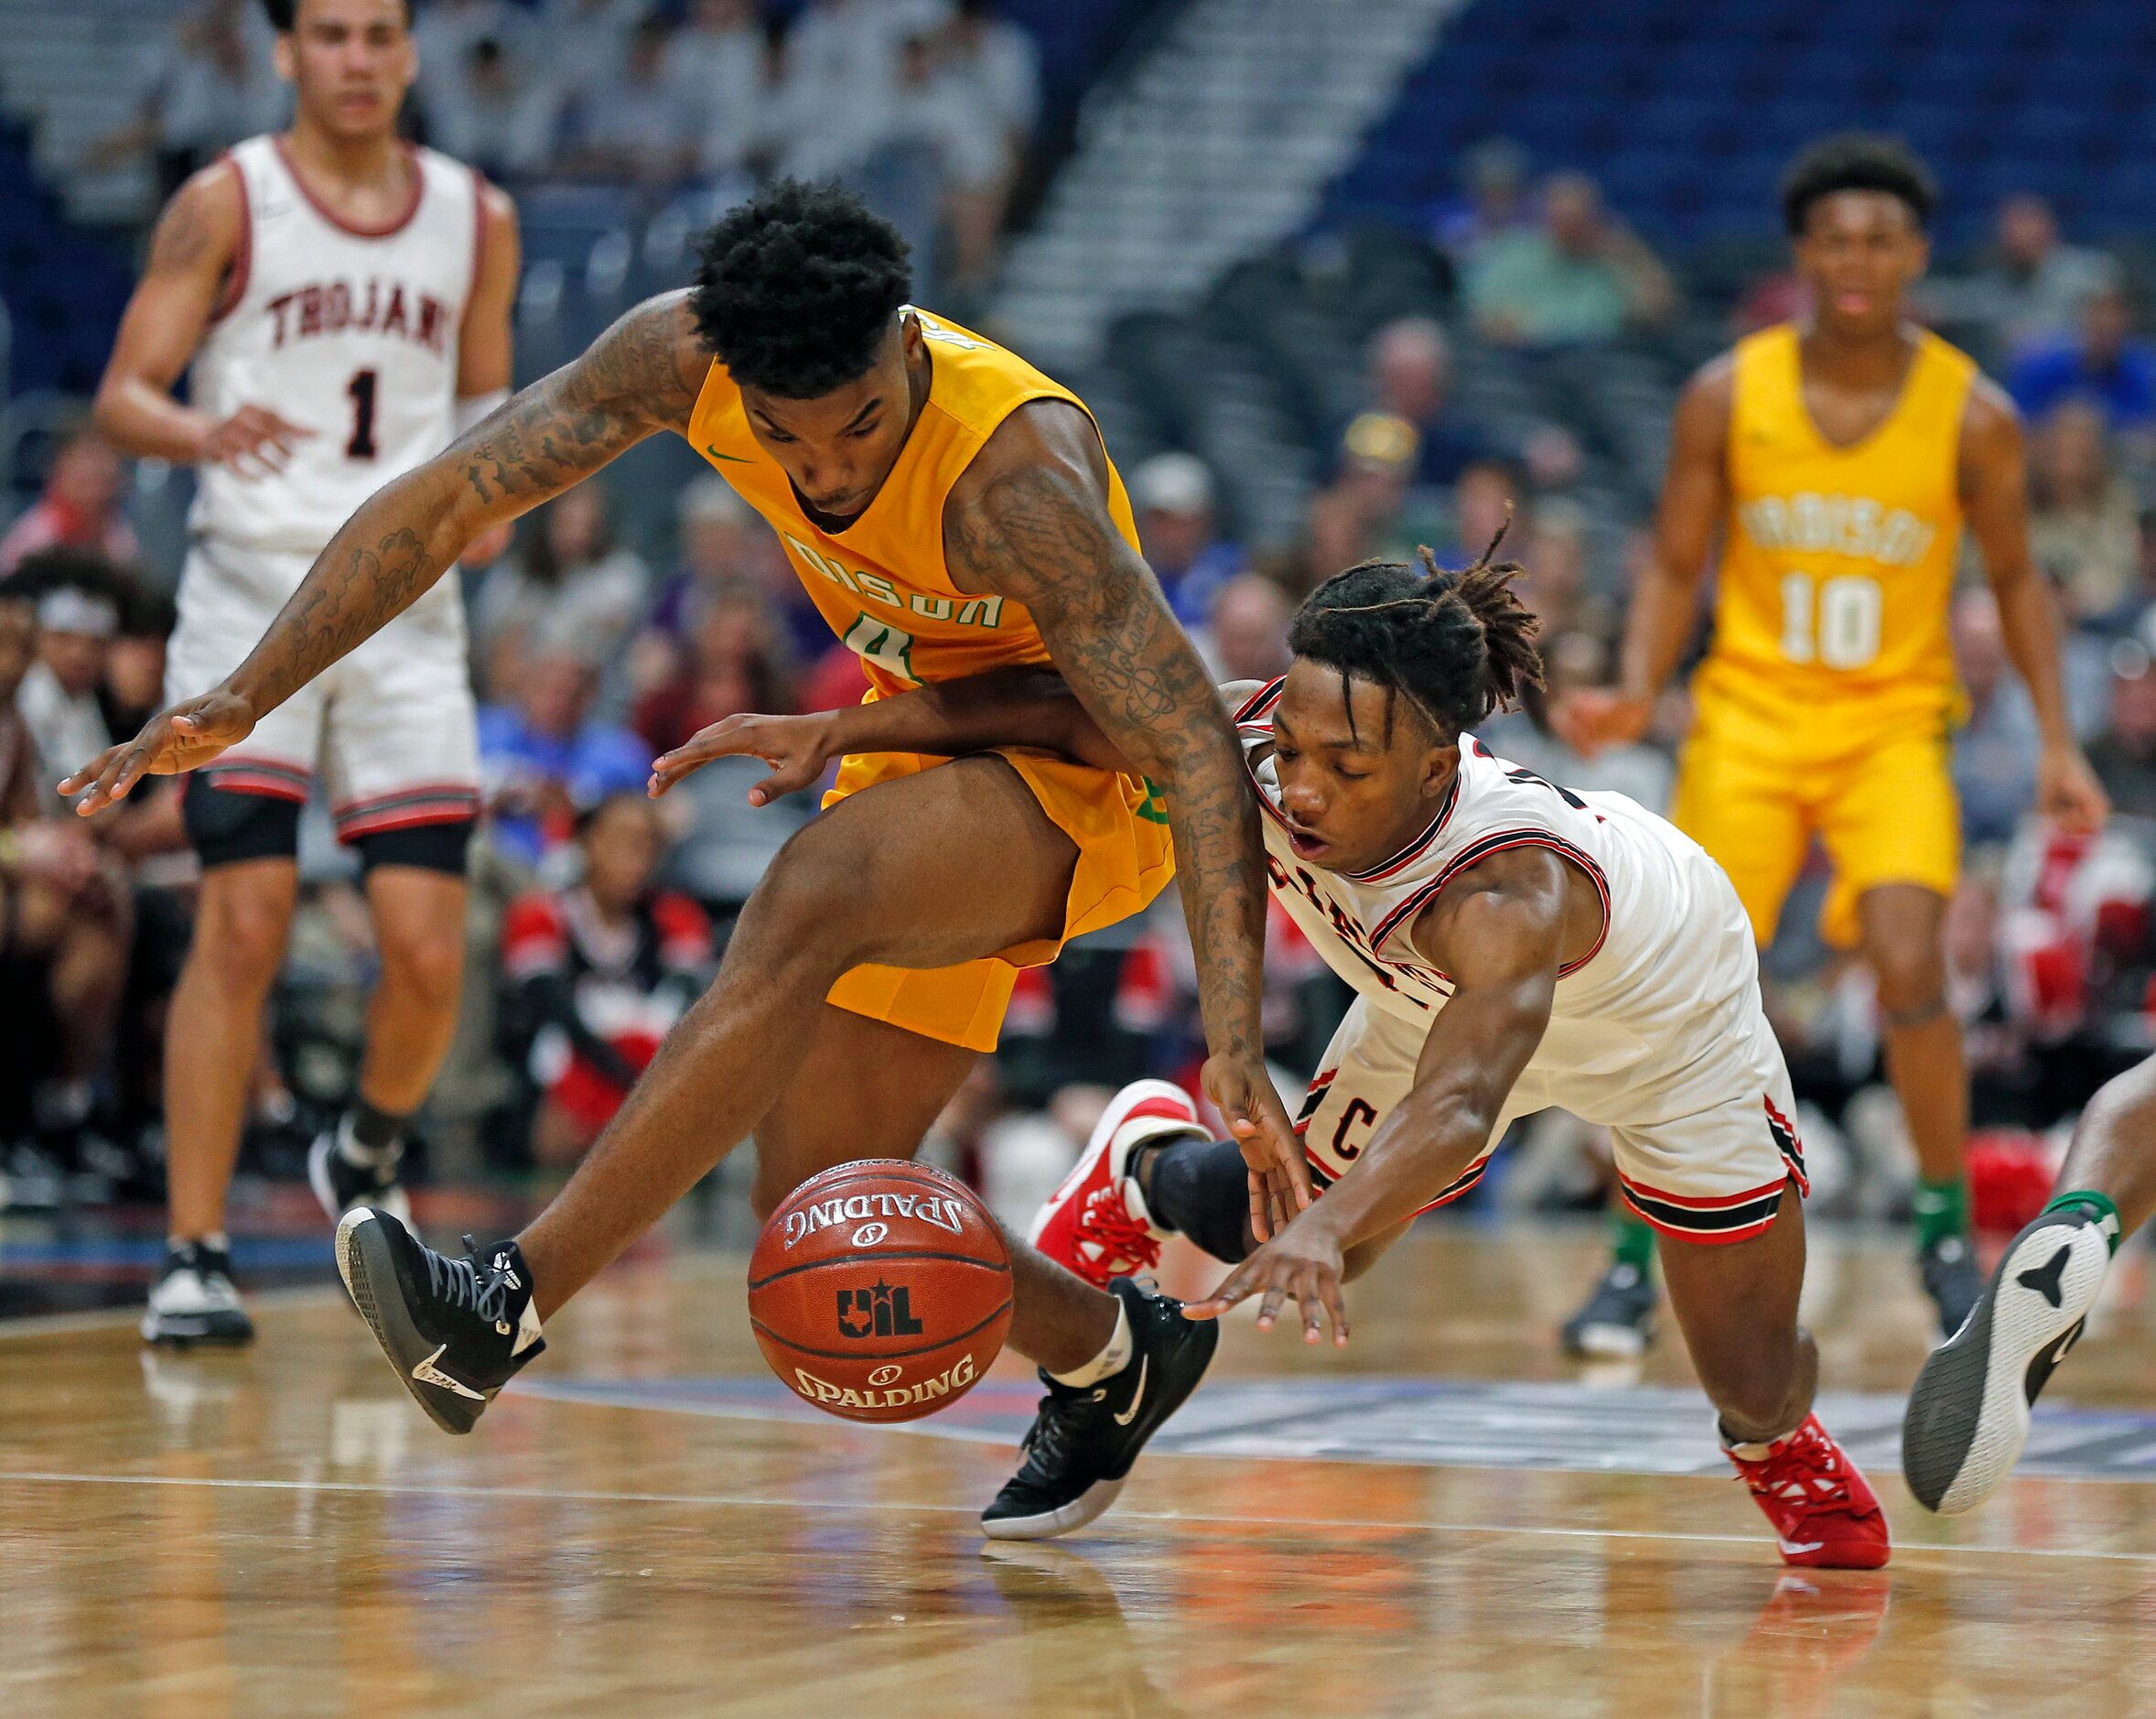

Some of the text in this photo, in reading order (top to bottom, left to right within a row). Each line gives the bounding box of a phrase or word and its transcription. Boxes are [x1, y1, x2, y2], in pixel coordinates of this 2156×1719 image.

[347, 368, 376, 459] 1
[1779, 571, 1882, 671] 10
[1332, 1097, 1378, 1161] C
[784, 1194, 963, 1250] SPALDING
[794, 1353, 976, 1408] SPALDING
